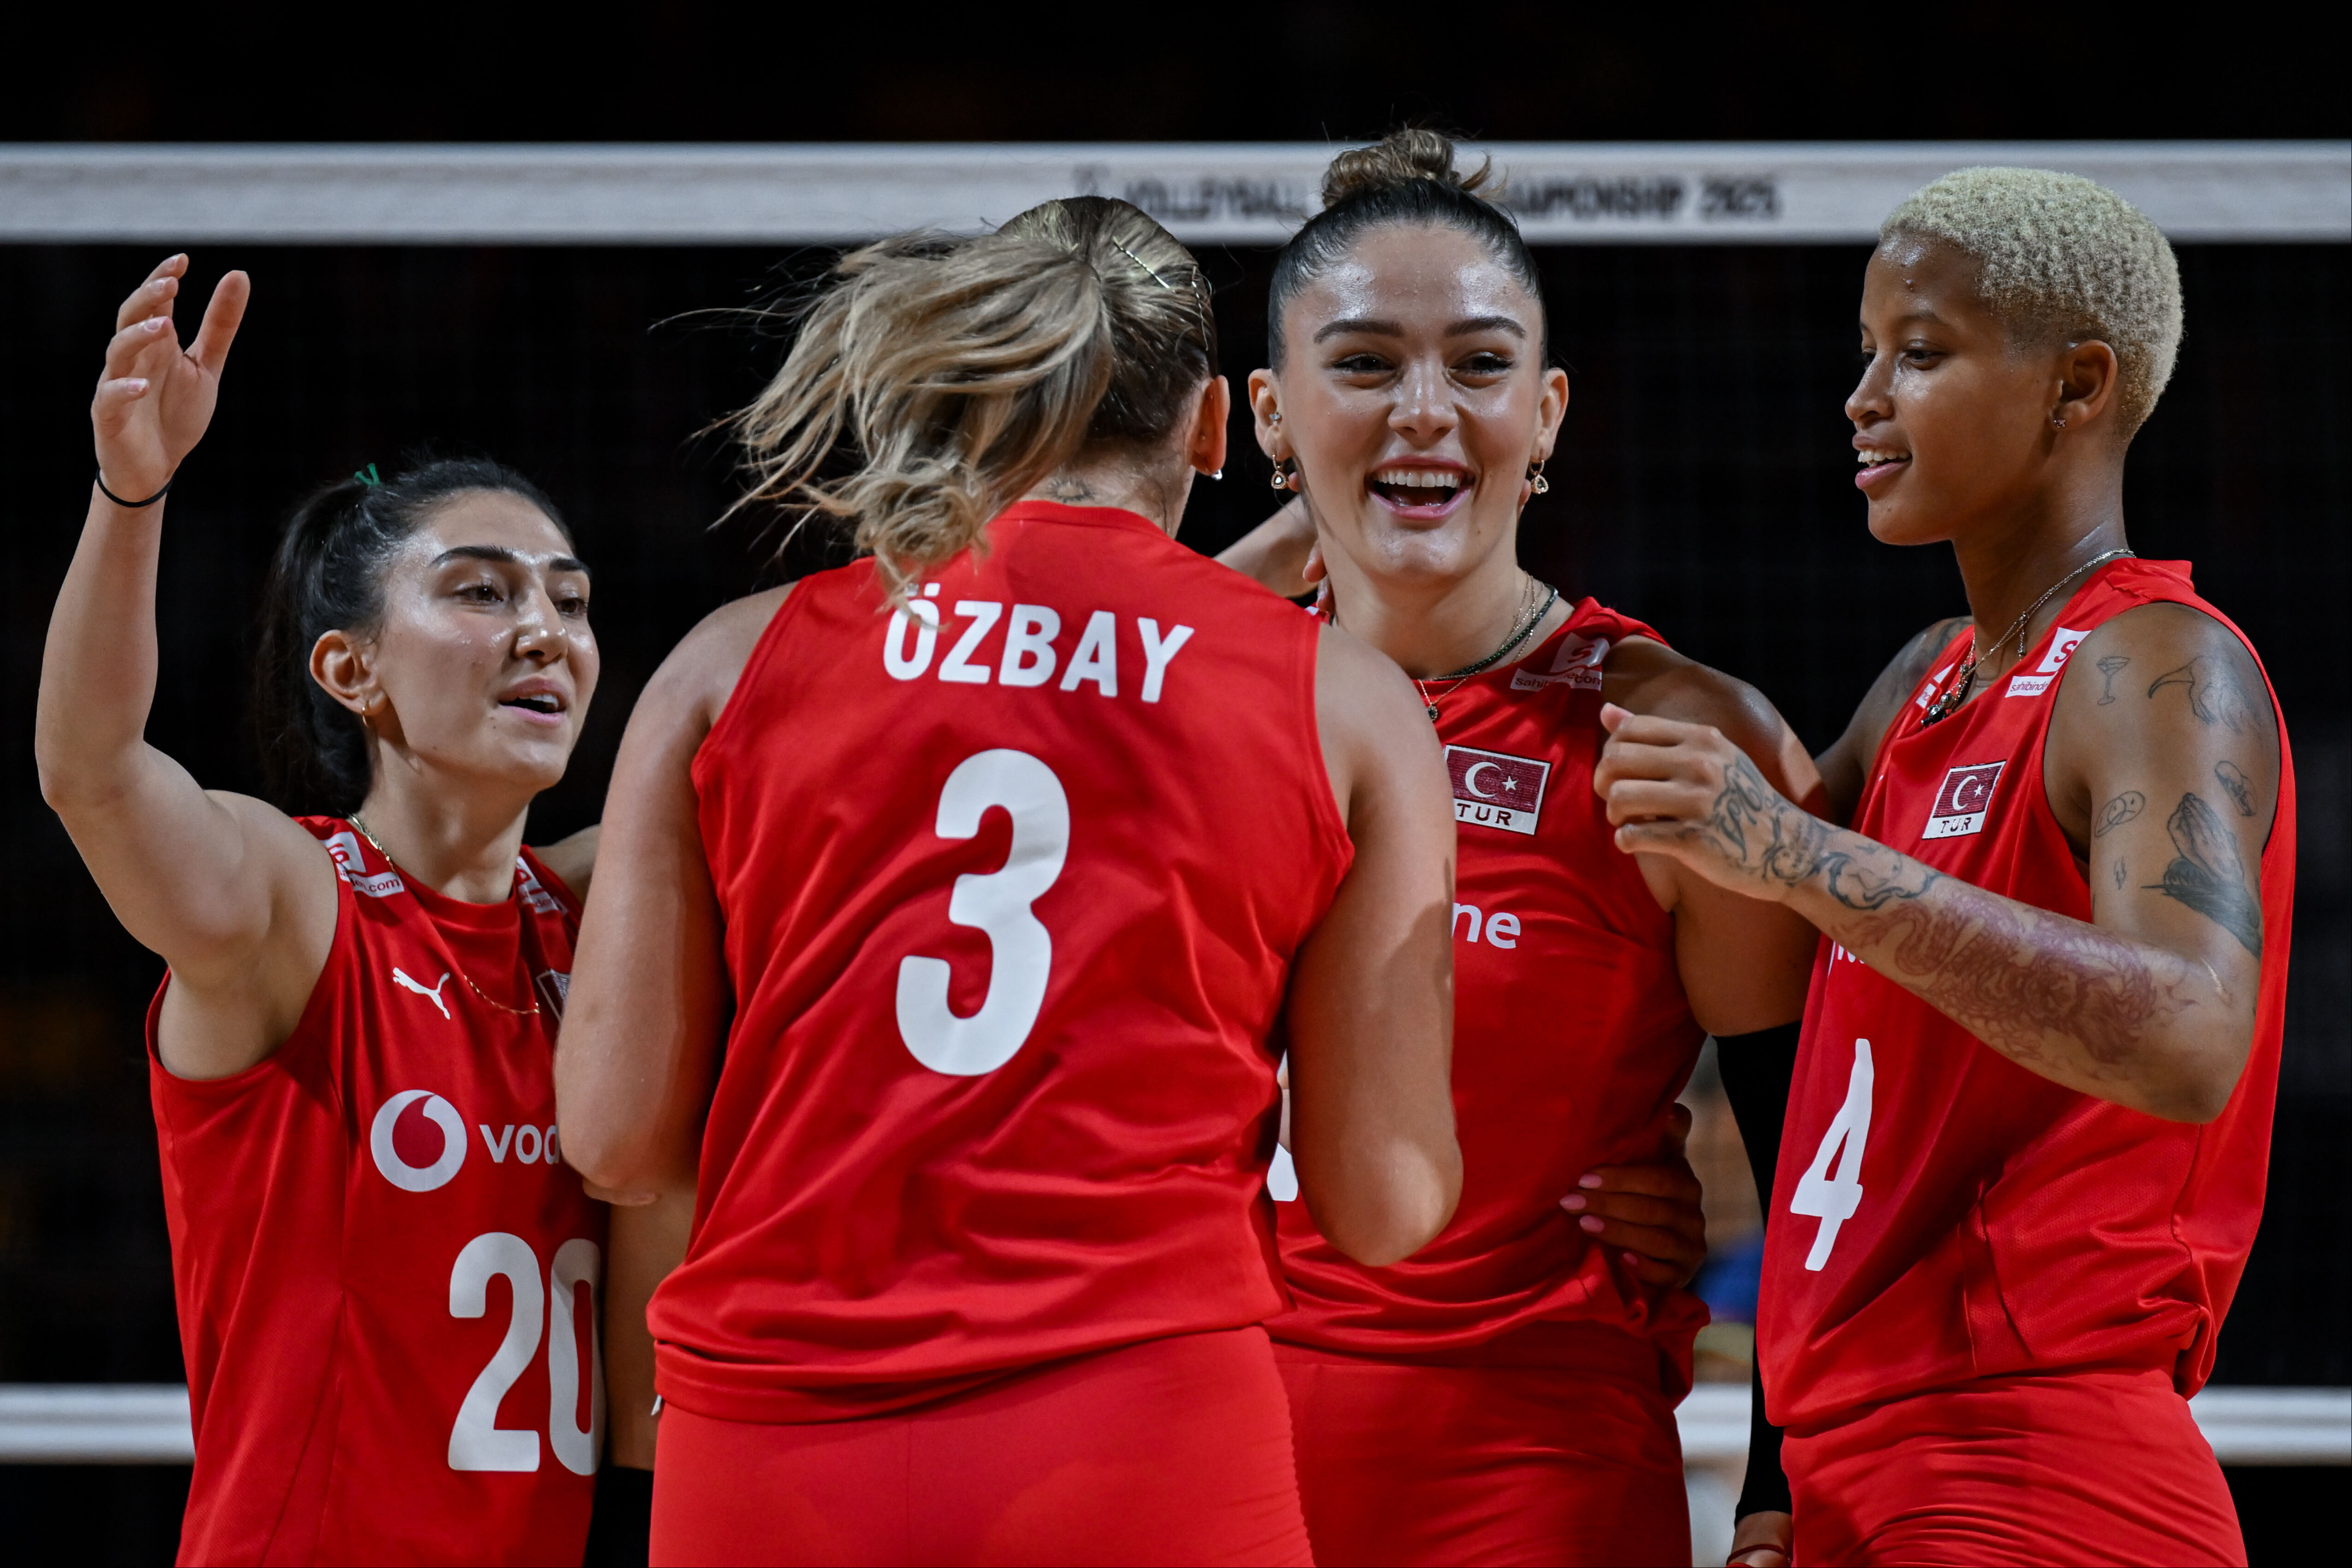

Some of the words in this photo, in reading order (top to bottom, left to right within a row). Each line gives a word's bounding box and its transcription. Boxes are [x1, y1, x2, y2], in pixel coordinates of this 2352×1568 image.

[883, 583, 1195, 704] ÖZBAY
[1457, 803, 1512, 826] TUR
[1941, 817, 1972, 834] TUR
[895, 748, 1070, 1076] 3
[1790, 1038, 1874, 1272] 4
[448, 1232, 606, 1475] 20
